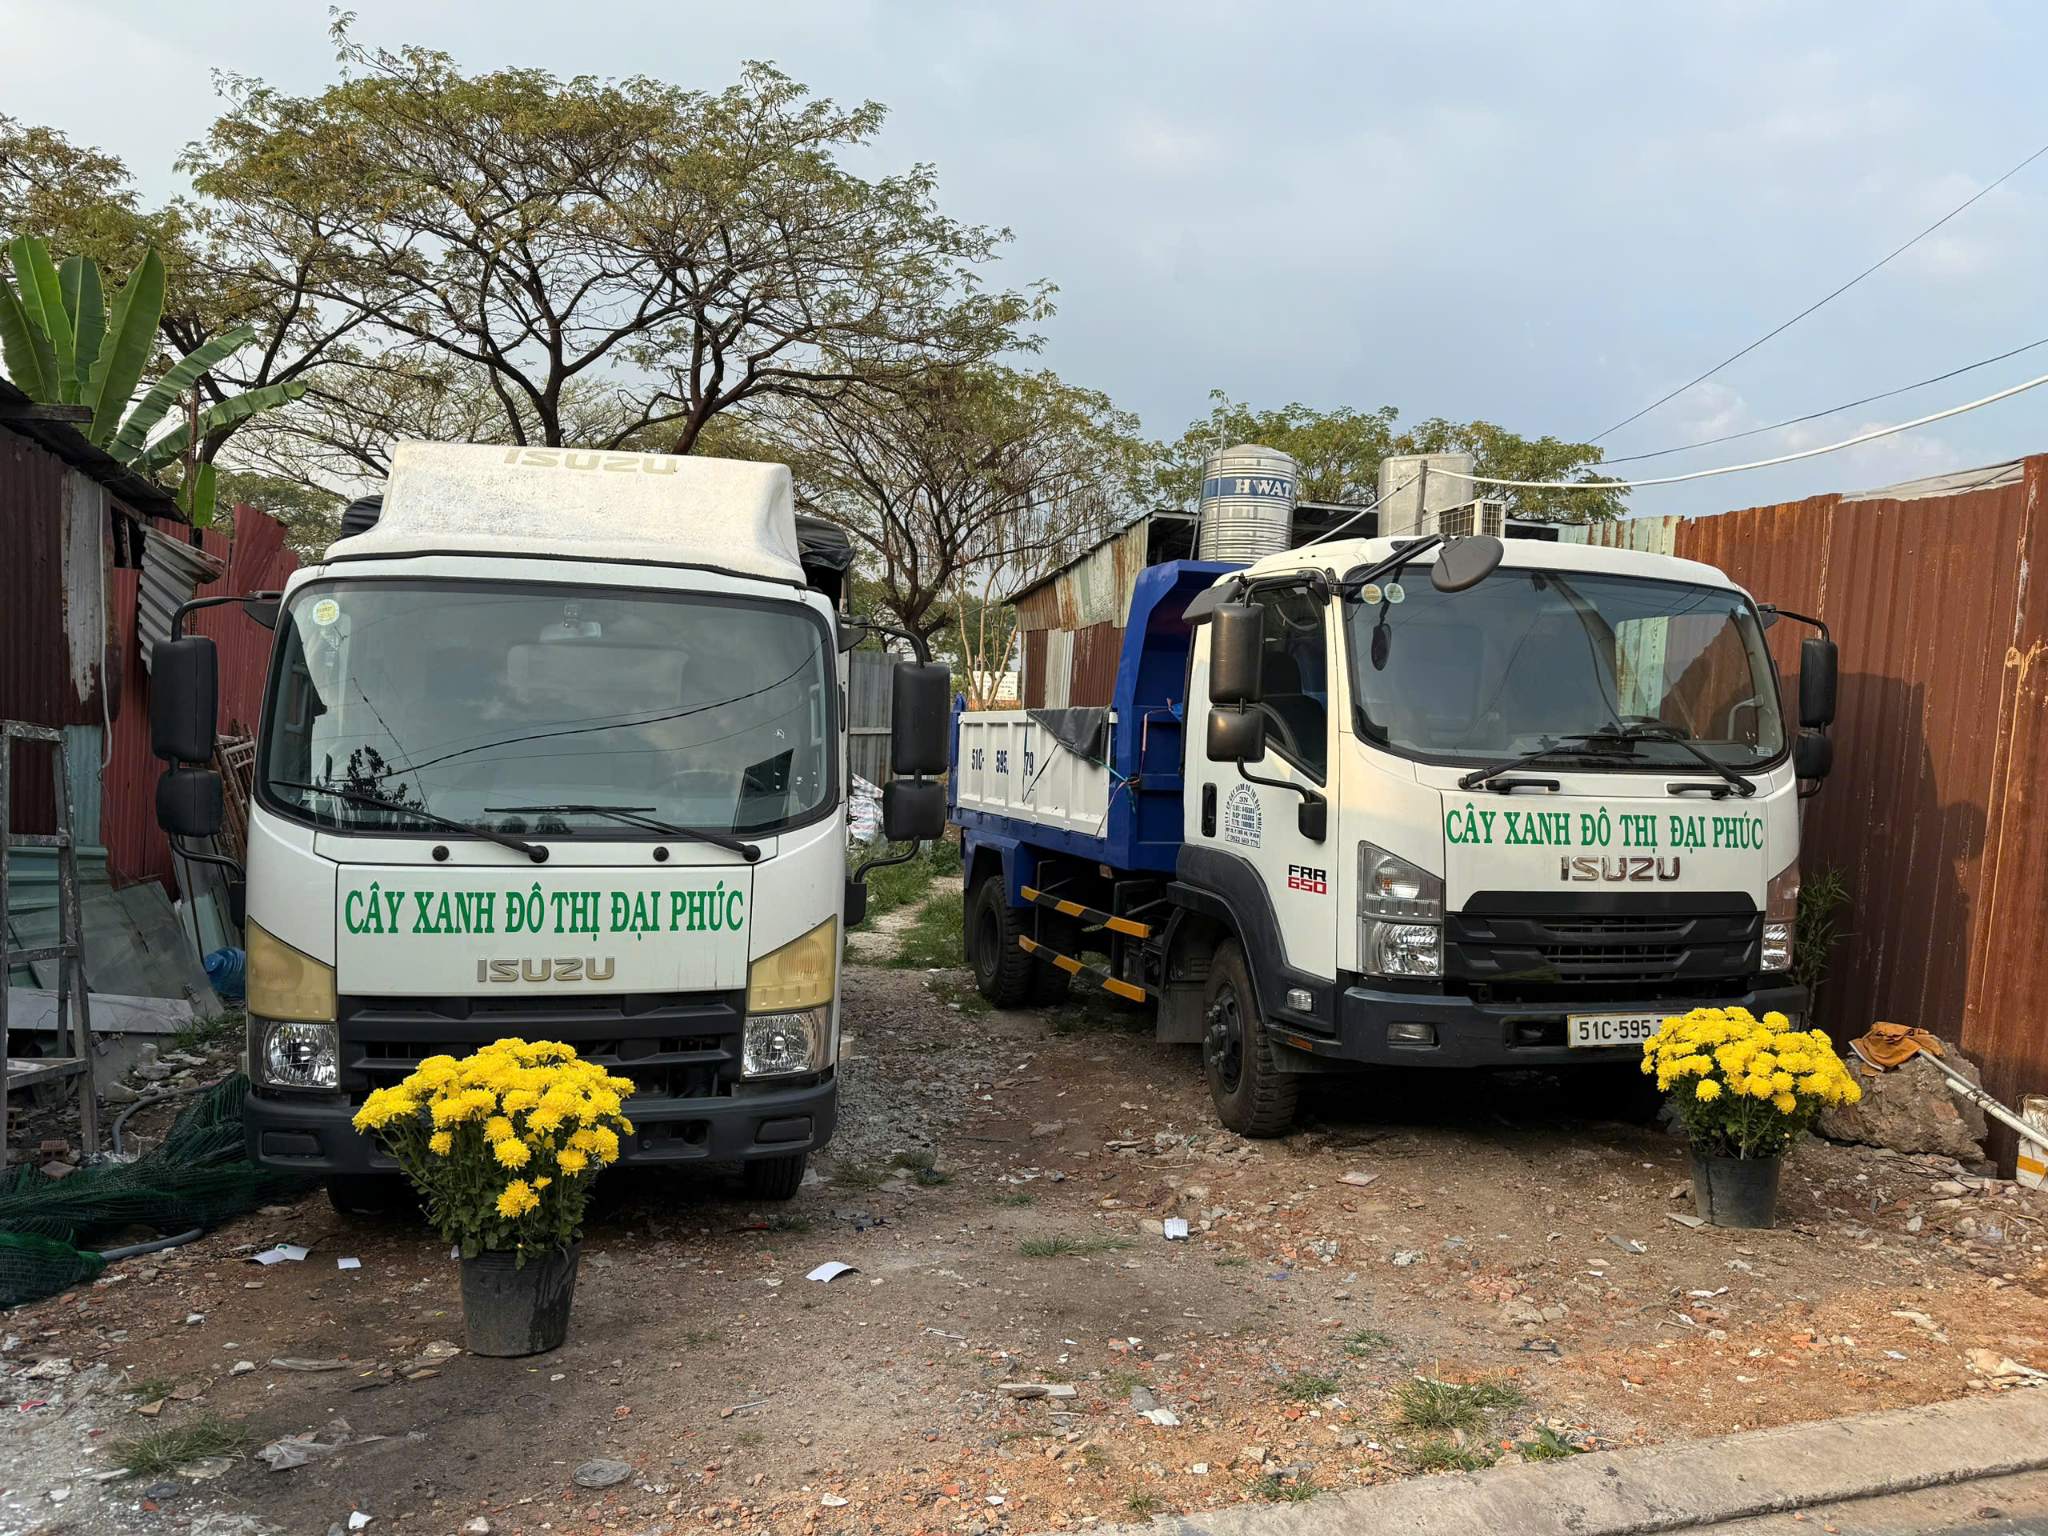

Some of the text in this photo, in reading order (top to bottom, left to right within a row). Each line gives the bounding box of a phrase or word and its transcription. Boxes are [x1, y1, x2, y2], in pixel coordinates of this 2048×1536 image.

[504, 449, 677, 475] ISUZU
[1447, 802, 1764, 854] CÂY XANH ĐÔ THỊ ĐẠI PHÚC
[1288, 864, 1327, 882] FRR
[1561, 855, 1681, 882] ISUZU
[1287, 876, 1327, 895] 650
[345, 880, 744, 941] CÂY XANH ĐÔ THỊ ĐẠI PHÚC
[477, 957, 616, 983] ISUZU
